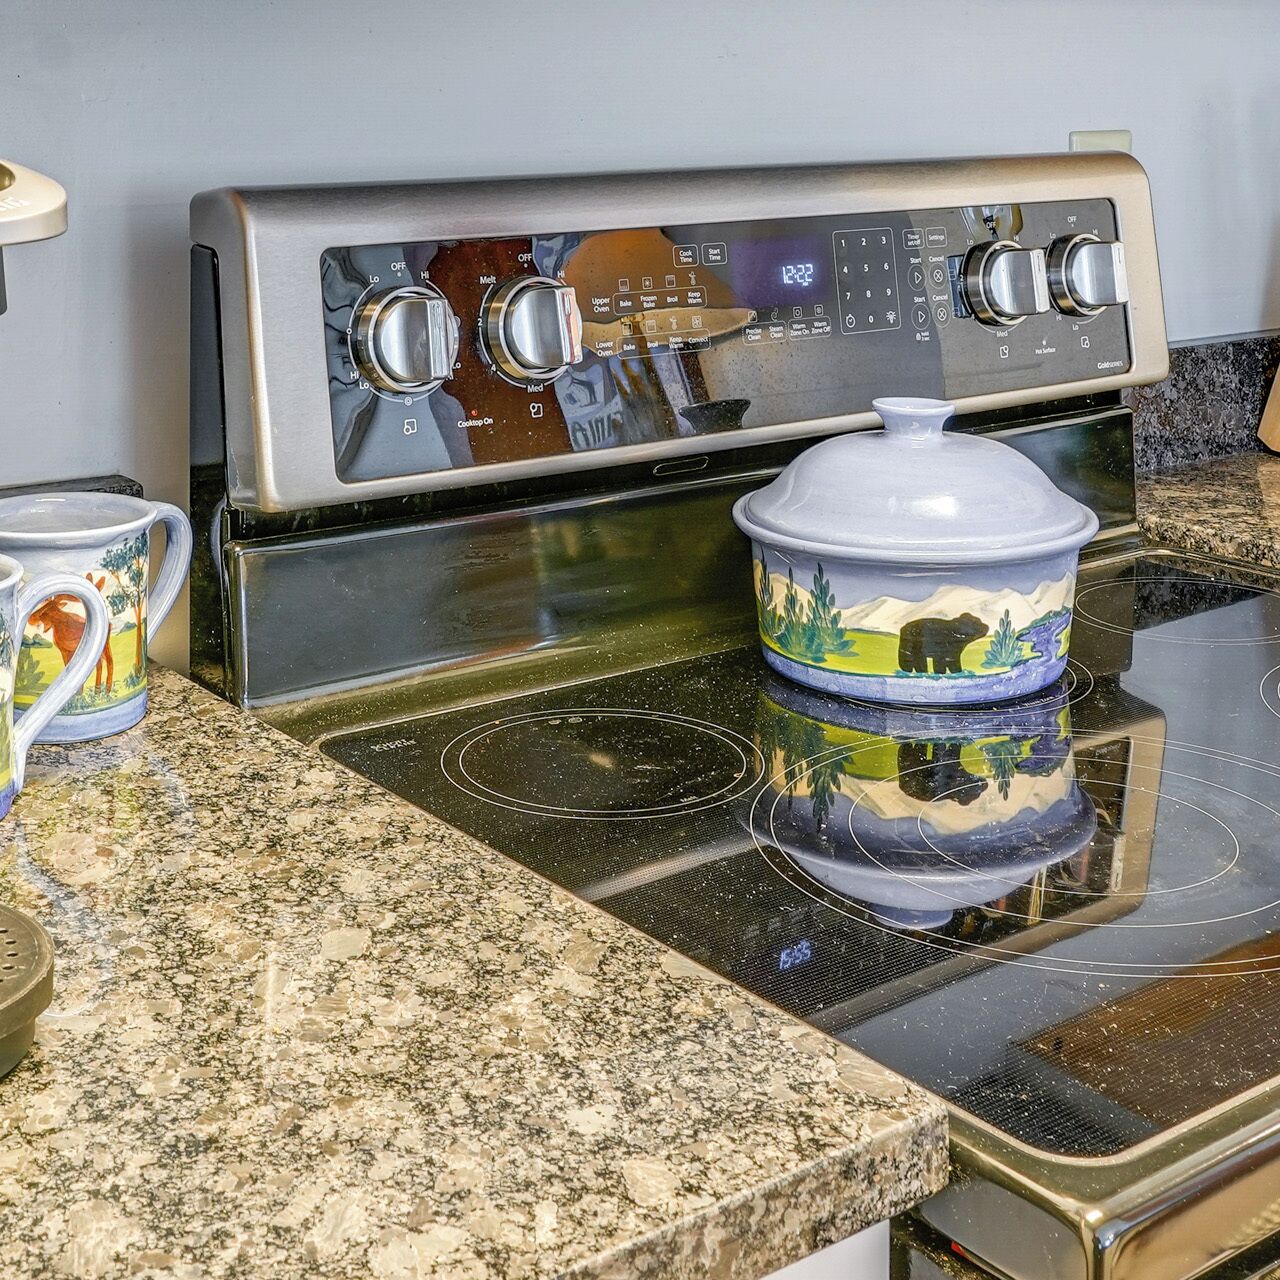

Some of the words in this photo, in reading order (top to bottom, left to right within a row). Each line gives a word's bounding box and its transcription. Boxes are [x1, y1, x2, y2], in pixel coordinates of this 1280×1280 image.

[1067, 215, 1077, 223] OFF
[841, 239, 846, 247] 1
[861, 238, 867, 246] 2
[881, 236, 887, 244] 3
[517, 253, 532, 262] OFF
[928, 255, 945, 263] Cancel
[390, 262, 407, 270] OFF
[842, 266, 848, 274] 4
[863, 264, 869, 272] 5
[420, 271, 430, 280] Hi
[557, 270, 565, 279] Hi
[782, 263, 814, 284] 12:22
[369, 275, 380, 283] Lo
[479, 275, 497, 285] Melt
[687, 291, 701, 299] Keep
[845, 292, 851, 300] 7
[866, 290, 871, 298] 8
[886, 288, 891, 296] 9
[591, 297, 610, 306] Upper
[666, 295, 678, 303] Broil
[477, 318, 483, 326] 2
[868, 315, 874, 323] 0
[996, 330, 1008, 338] Med
[595, 341, 613, 349] Lower
[597, 349, 613, 357] Oven
[490, 363, 497, 372] 4
[350, 371, 360, 380] Hi
[359, 381, 370, 390] Lo
[526, 383, 544, 393] Med
[457, 419, 484, 429] Cooktop
[483, 417, 494, 425] On
